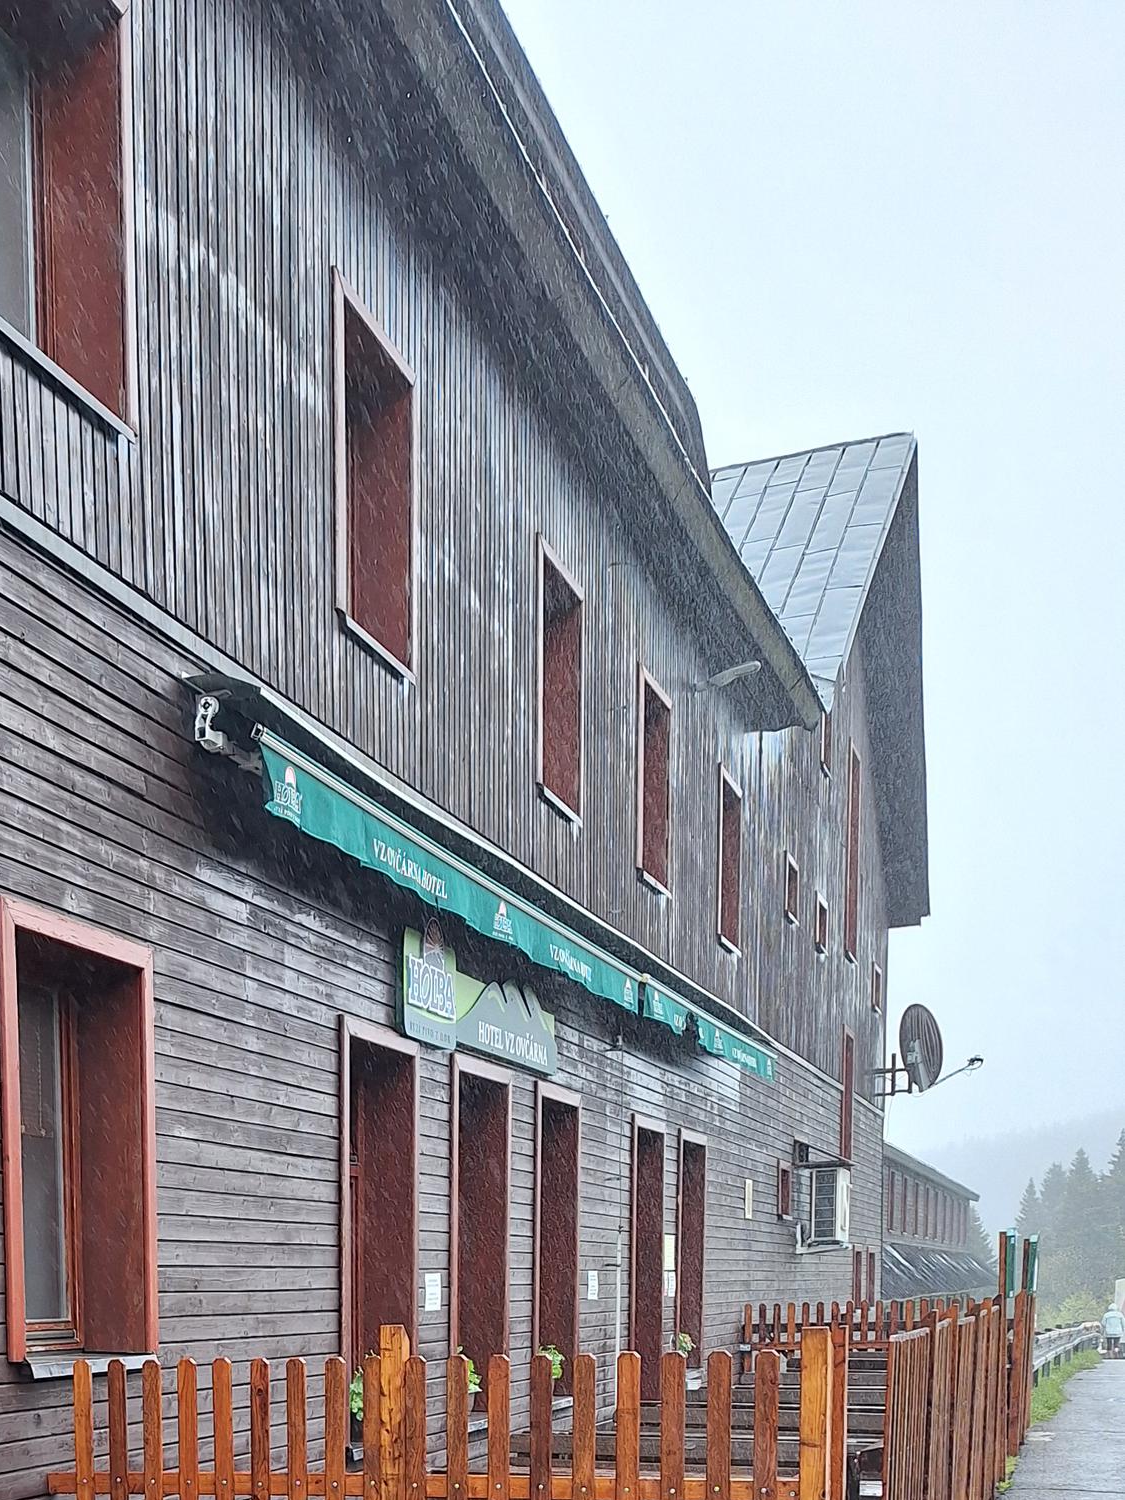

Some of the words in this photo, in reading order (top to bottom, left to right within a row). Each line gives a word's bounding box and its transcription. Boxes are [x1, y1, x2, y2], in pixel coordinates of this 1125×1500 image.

[373, 838, 386, 862] VZ
[422, 869, 448, 899] HOTEL
[408, 953, 456, 1020] HOLBA
[478, 1020, 504, 1050] HOTEL
[504, 1030, 515, 1054] VZ
[515, 1032, 548, 1066] OVČÁRNA
